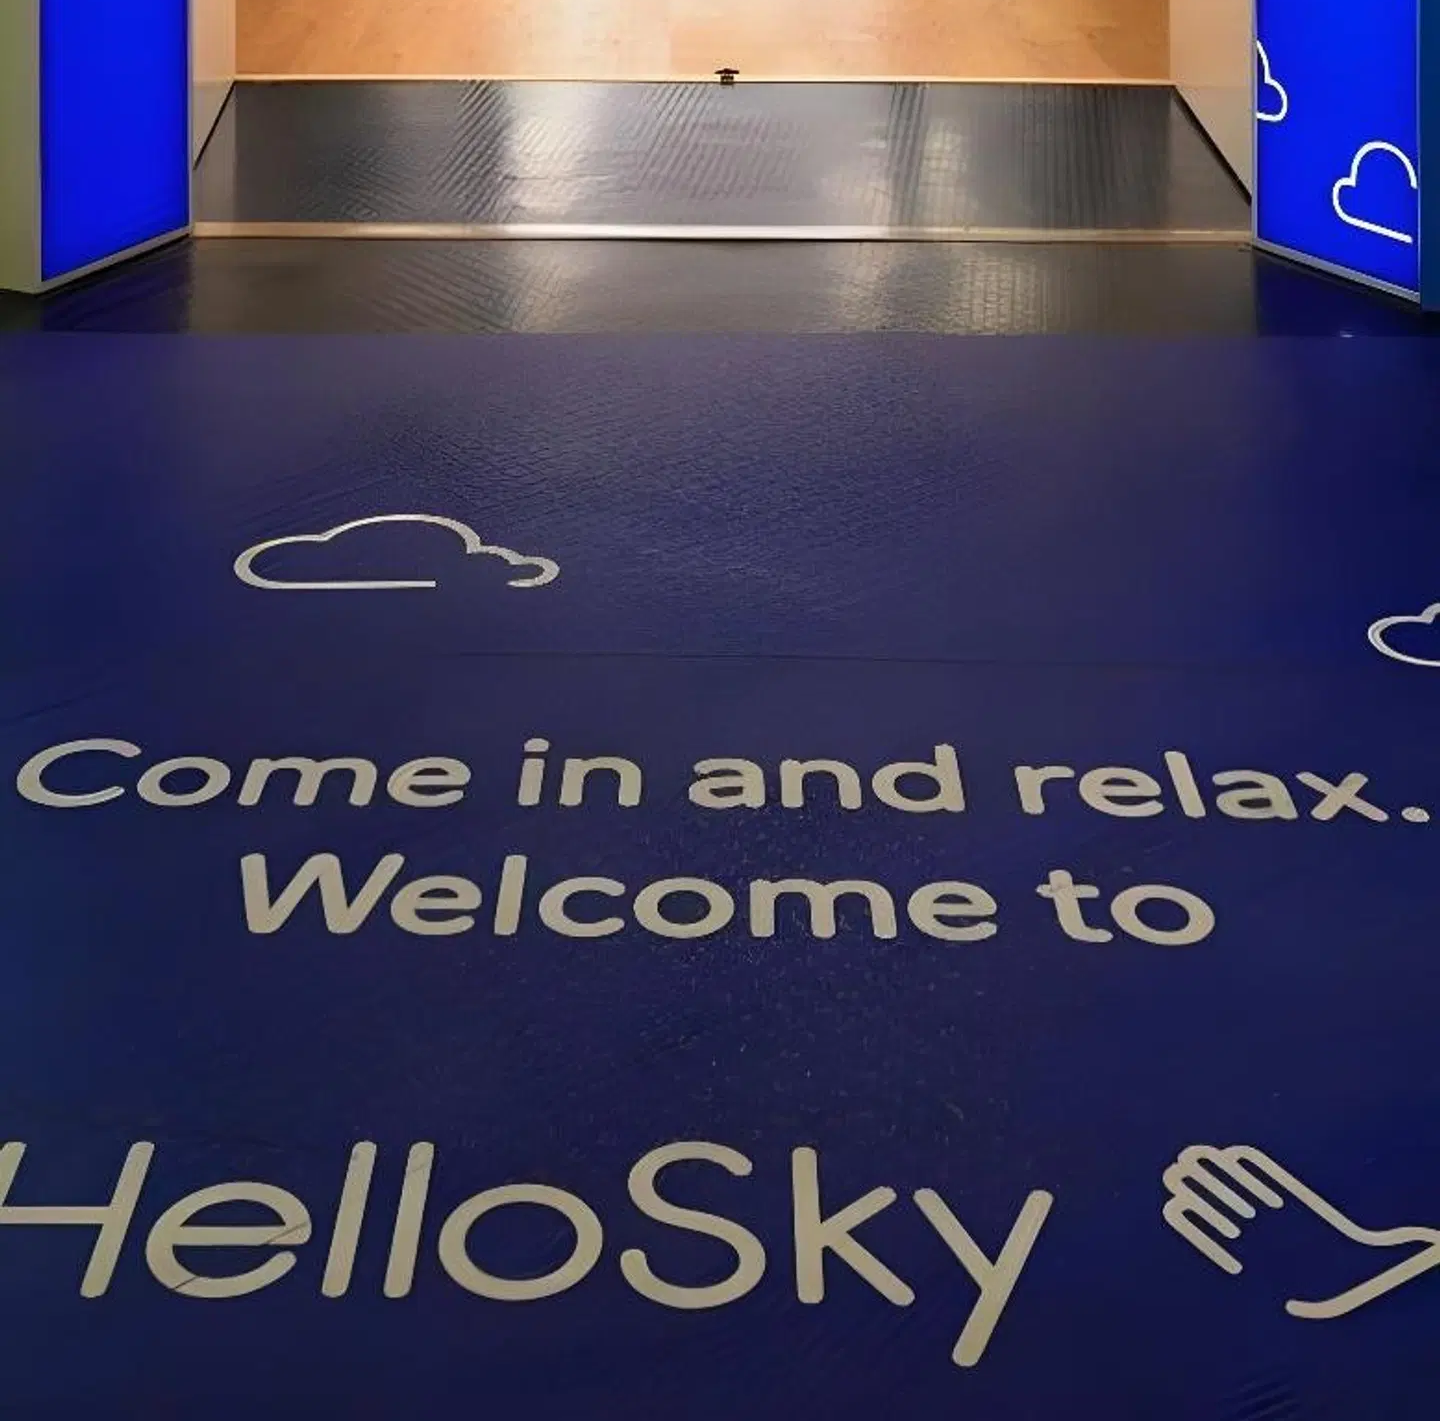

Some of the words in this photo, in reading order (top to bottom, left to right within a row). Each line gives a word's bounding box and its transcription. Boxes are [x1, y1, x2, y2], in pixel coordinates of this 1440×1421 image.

[16, 738, 471, 808] Come
[517, 737, 643, 807] in
[688, 743, 965, 813] and
[1013, 750, 1430, 822] relax.
[240, 852, 998, 942] Welcome
[1036, 869, 1216, 946] to
[0, 1140, 1054, 1368] HelloSky
